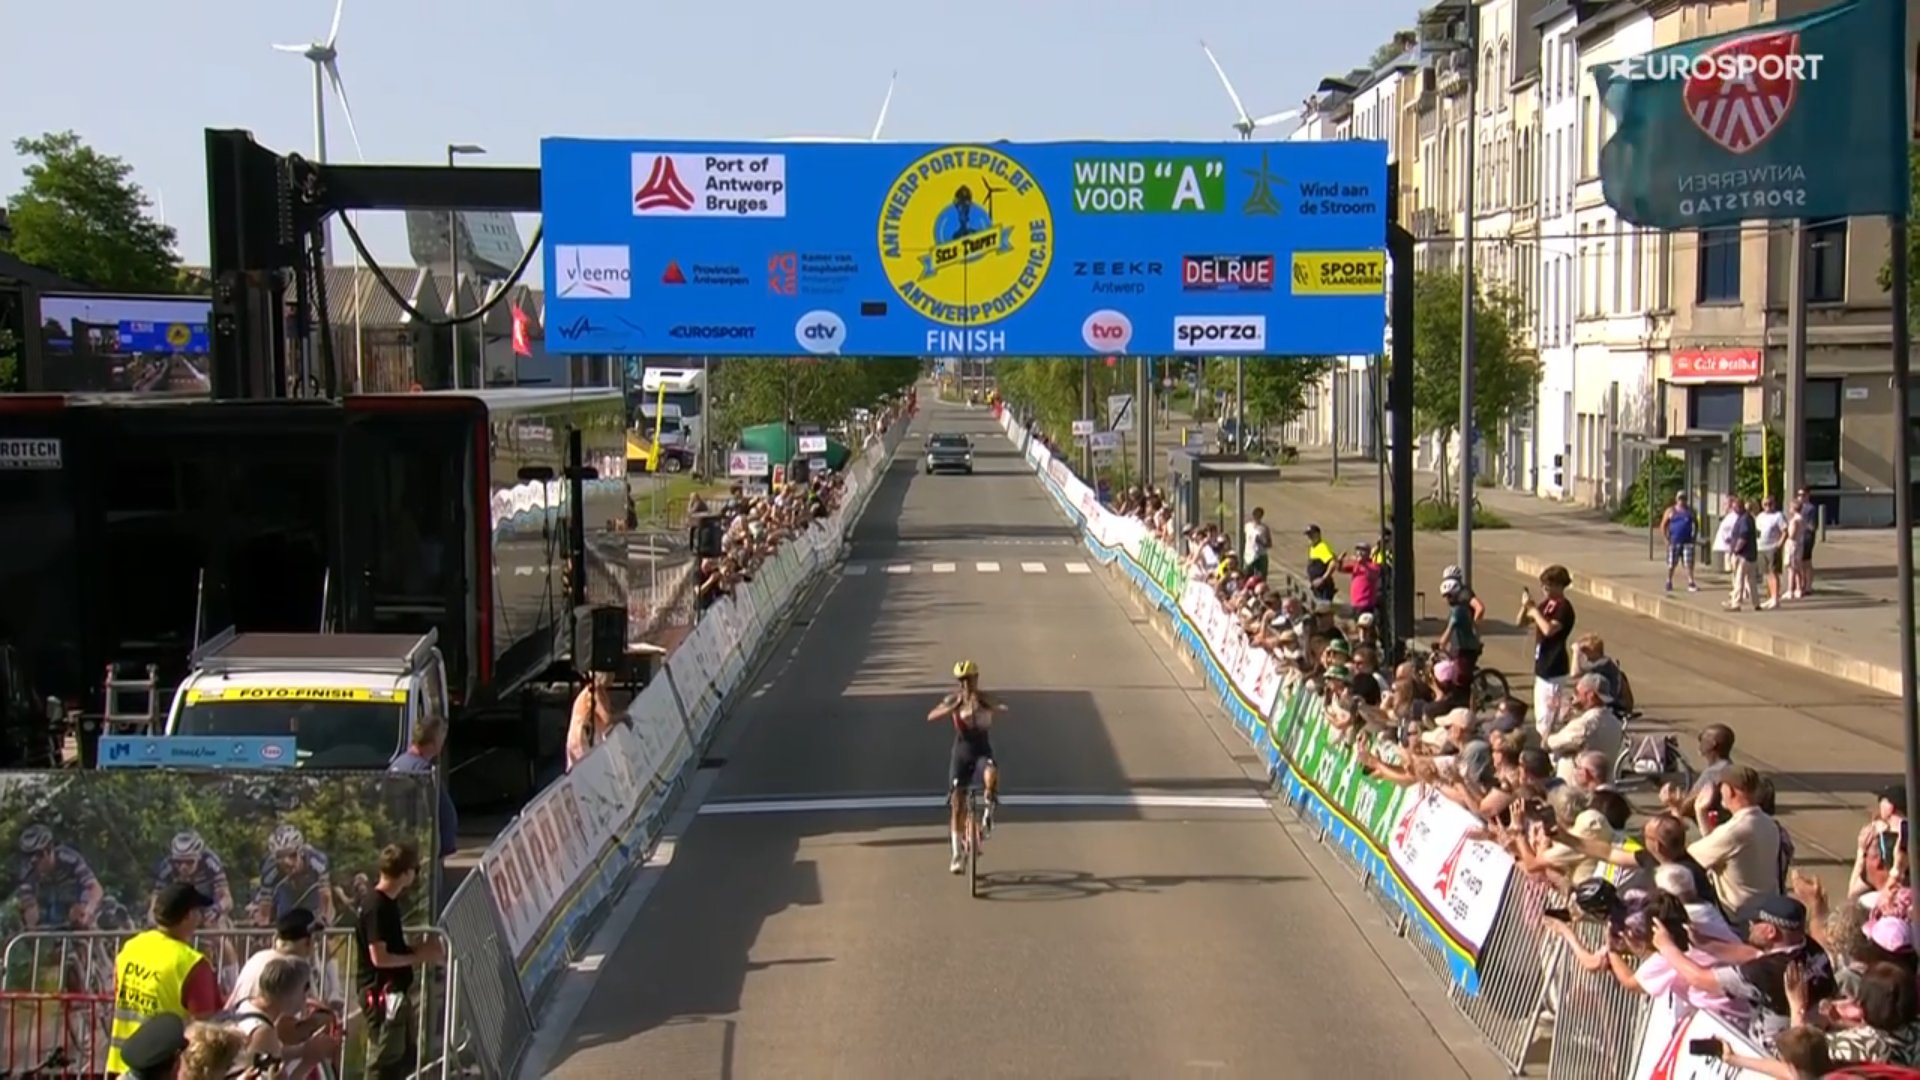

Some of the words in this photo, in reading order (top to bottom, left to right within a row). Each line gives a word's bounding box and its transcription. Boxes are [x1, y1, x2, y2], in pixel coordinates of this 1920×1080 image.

[705, 157, 745, 173] Port
[749, 157, 769, 173] of
[1074, 162, 1145, 184] WIND
[705, 176, 784, 195] Antwerp
[1300, 182, 1340, 197] Wind
[1343, 185, 1369, 197] aan
[705, 195, 769, 214] Bruges
[883, 172, 920, 258] ANTWERP
[918, 151, 965, 180] PORT
[967, 151, 1034, 196] EPIC.BE
[1074, 188, 1145, 210] VOOR
[1299, 201, 1318, 214] de
[1320, 200, 1376, 214] Stroom
[693, 264, 741, 274] Provincie
[801, 263, 858, 273] Koophandel
[899, 279, 981, 323] ANTWERP
[980, 283, 1025, 319] PORT
[1018, 218, 1047, 291] EPIC.BE
[1074, 261, 1163, 276] ZEEKR
[1186, 260, 1270, 284] DELRUE
[1320, 262, 1382, 276] SPORT.
[693, 276, 749, 287] Antwerpen
[1092, 281, 1145, 295] Antwerp
[1320, 276, 1383, 285] VLAANDEREN
[673, 326, 756, 339] EUROSPORT
[804, 323, 837, 339] atv
[1091, 322, 1123, 339] tvo
[926, 329, 1006, 352] FINISH
[239, 688, 354, 698] FOTO-FINISH
